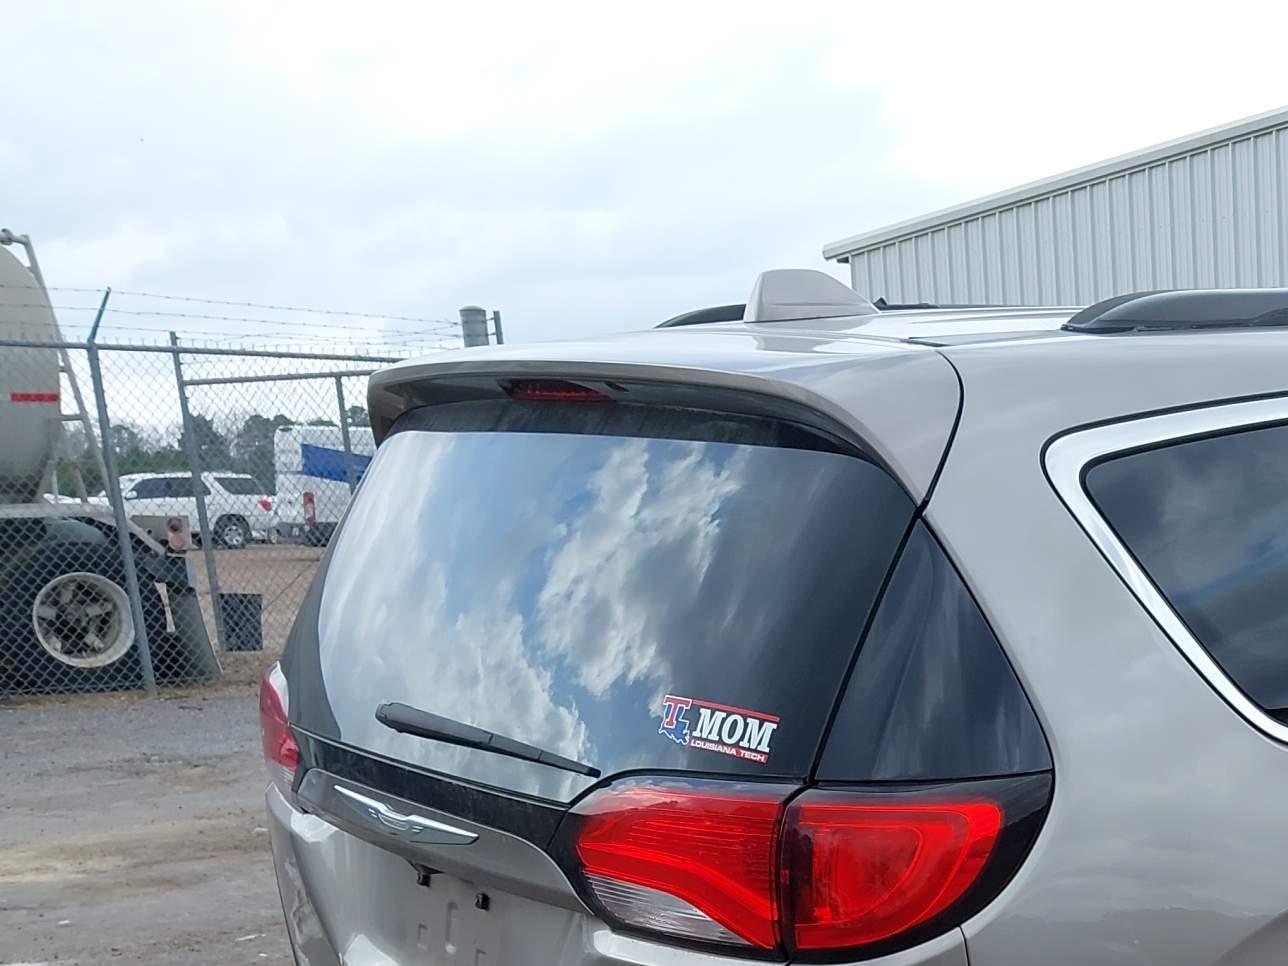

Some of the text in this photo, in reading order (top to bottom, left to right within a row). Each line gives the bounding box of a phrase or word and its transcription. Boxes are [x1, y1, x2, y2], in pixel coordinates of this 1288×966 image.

[692, 707, 778, 753] MOM
[690, 739, 766, 762] LOUISIANA TECH
